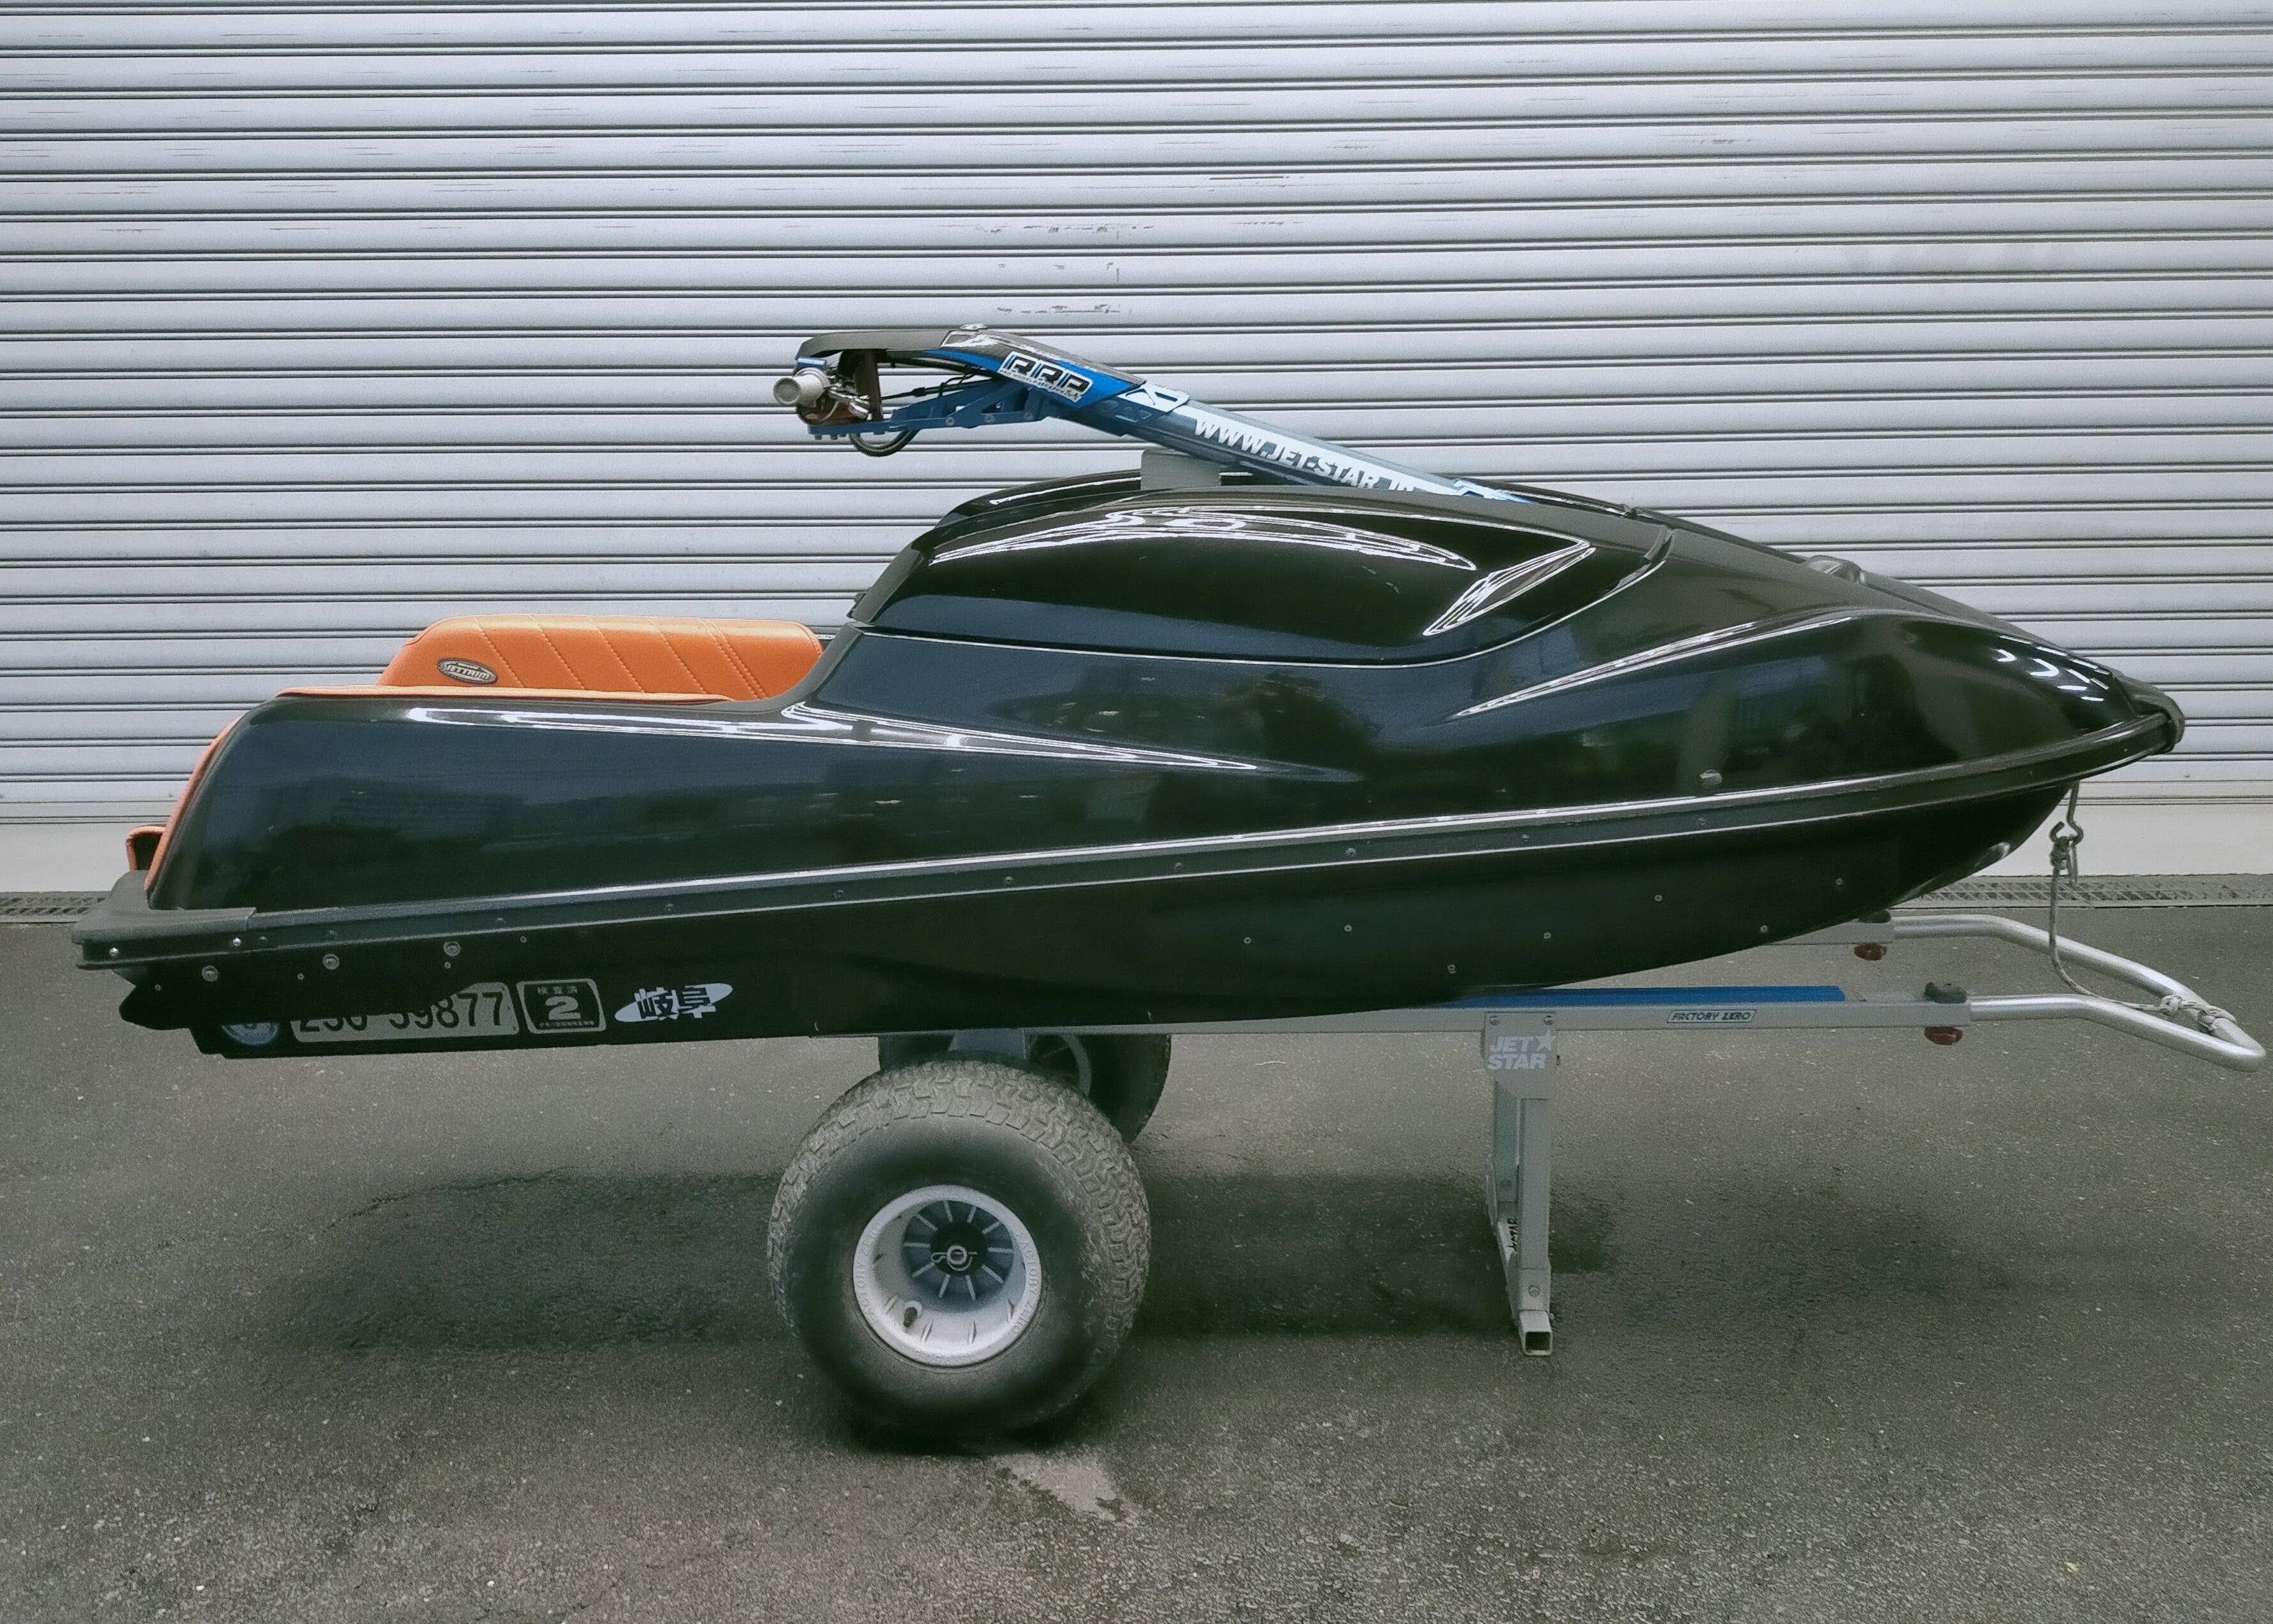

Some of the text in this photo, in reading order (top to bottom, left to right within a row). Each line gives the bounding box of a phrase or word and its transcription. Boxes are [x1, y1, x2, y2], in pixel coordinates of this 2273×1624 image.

[1003, 354, 1090, 392] RRP
[545, 996, 581, 1020] 2
[1672, 1012, 1751, 1021] FACTORY ZERO
[1489, 1035, 1535, 1053] JET
[1487, 1053, 1546, 1070] STAR
